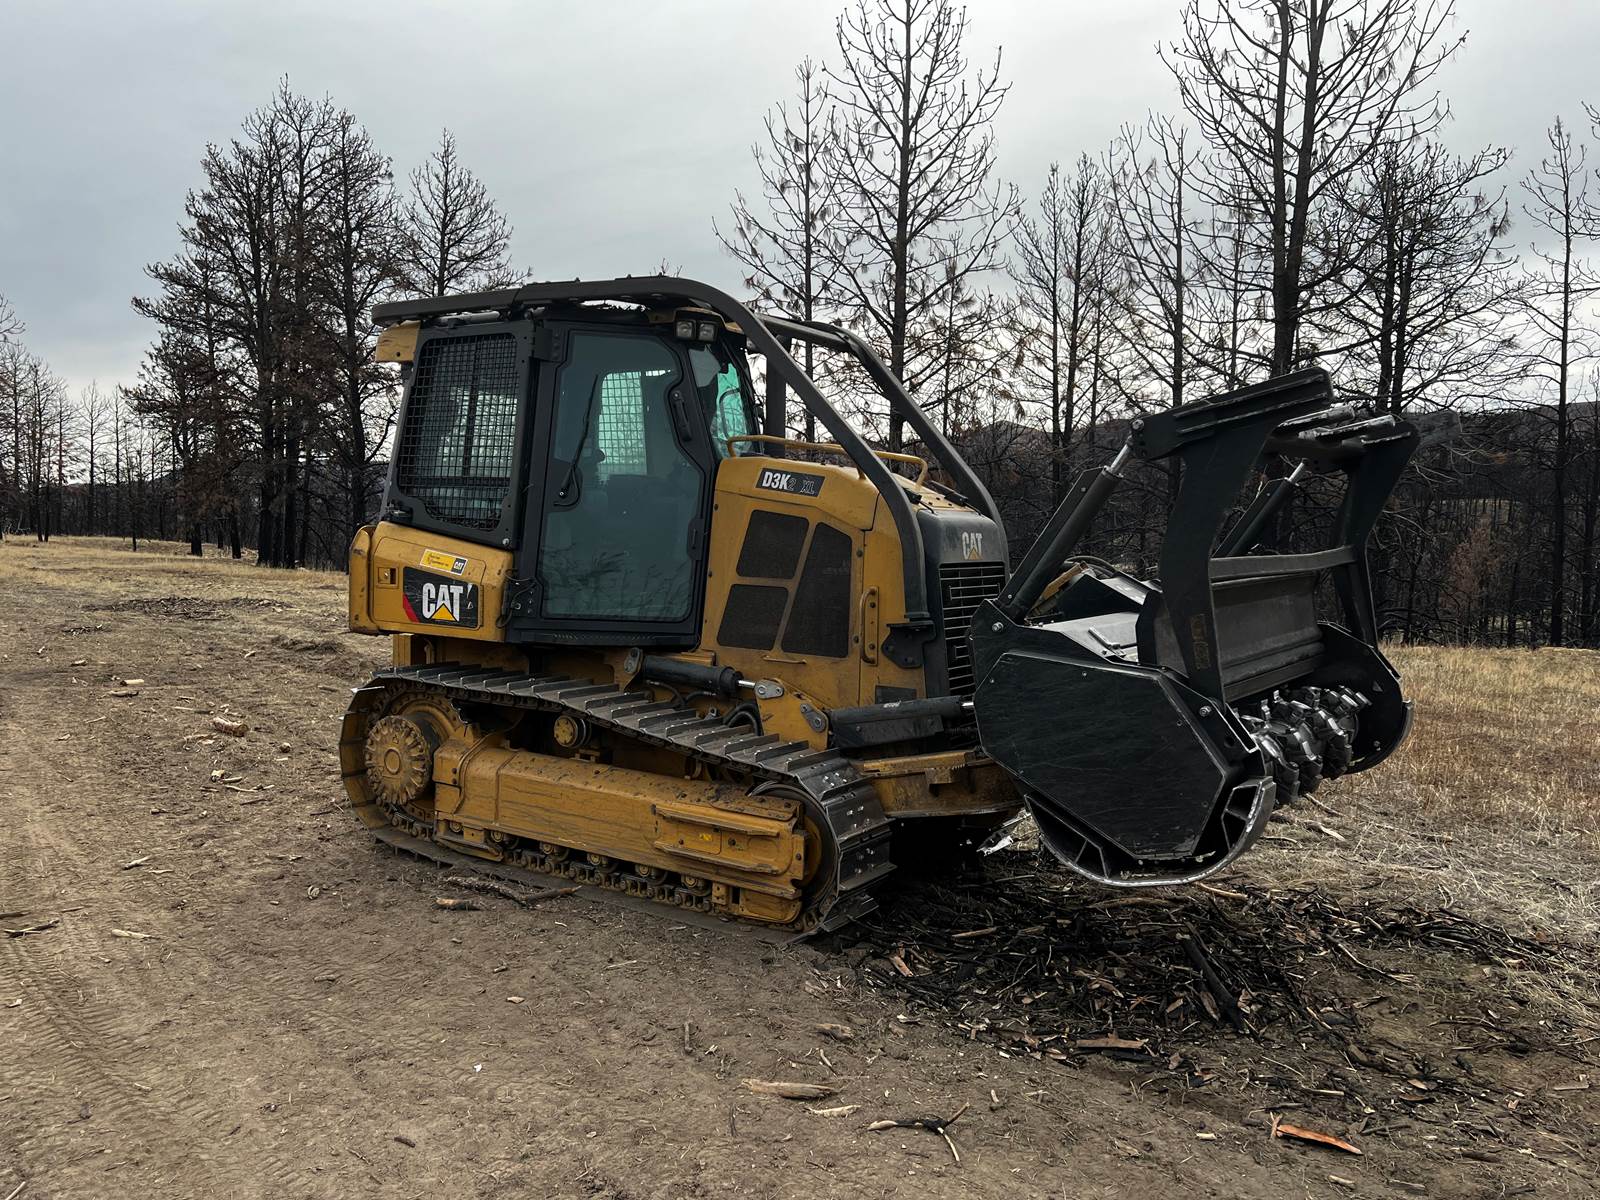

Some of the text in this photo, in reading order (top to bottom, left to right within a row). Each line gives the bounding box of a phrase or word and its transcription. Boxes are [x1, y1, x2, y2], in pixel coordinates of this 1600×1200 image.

[962, 531, 983, 560] CAT
[454, 561, 465, 570] CAT
[422, 582, 464, 622] CAT
